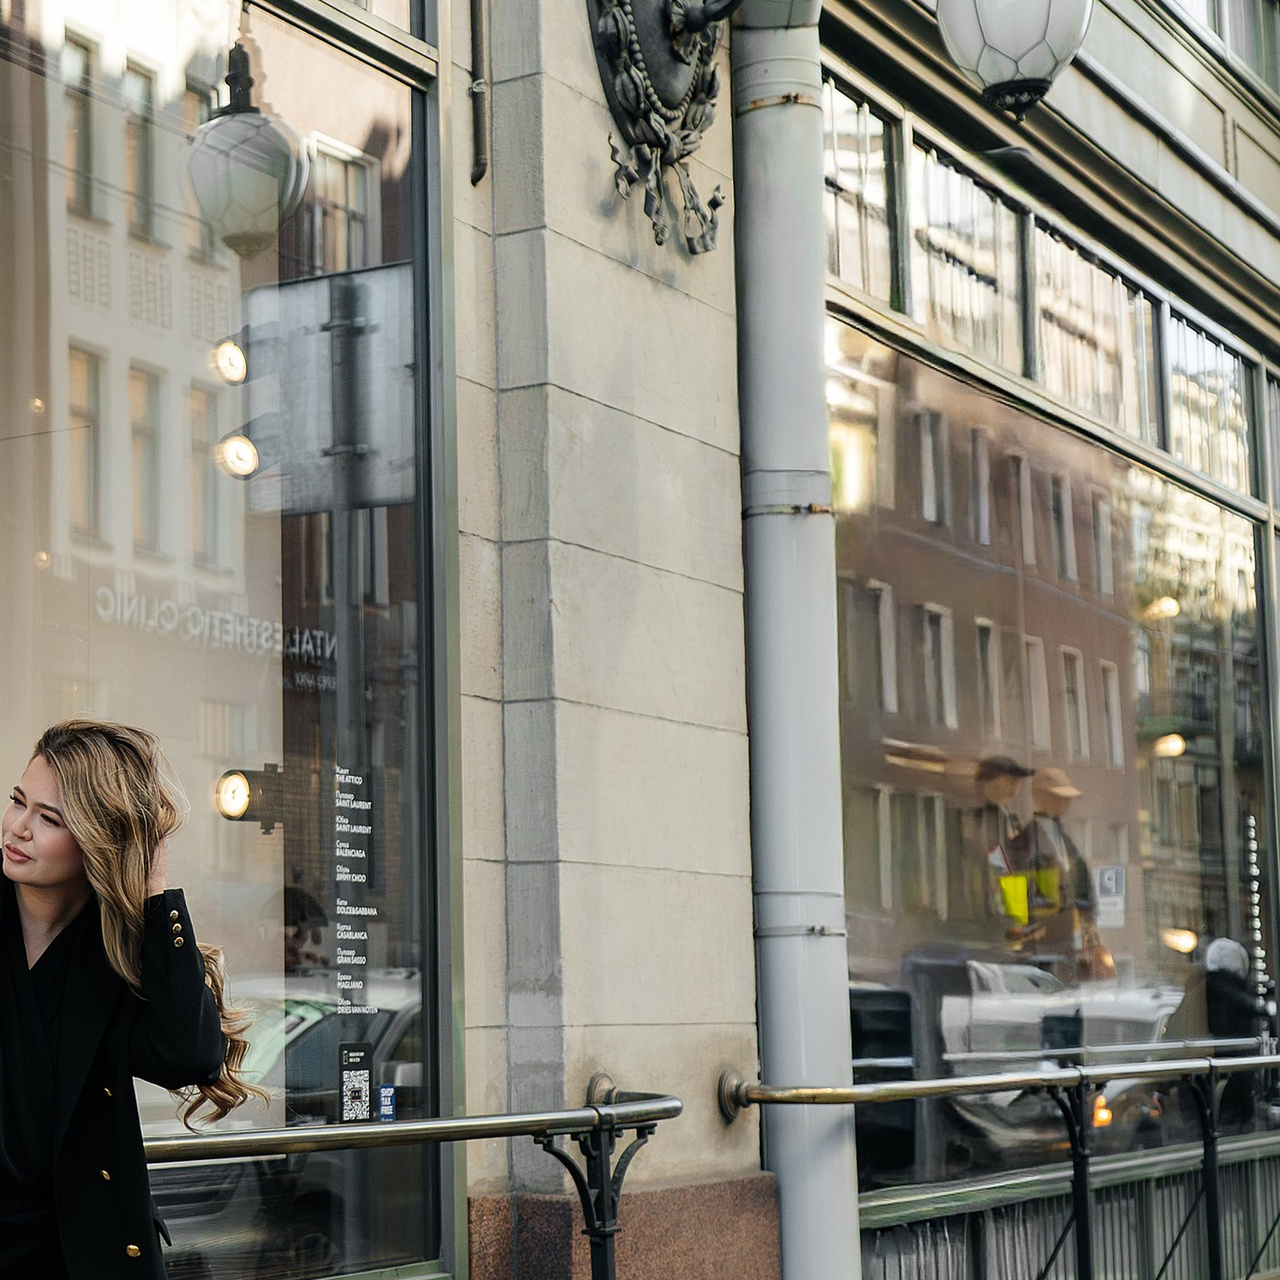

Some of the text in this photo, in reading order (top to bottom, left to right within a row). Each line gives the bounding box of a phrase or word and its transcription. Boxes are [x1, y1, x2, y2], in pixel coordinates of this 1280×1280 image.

[335, 773, 363, 785] THE ATTICO
[336, 798, 372, 810] SAINT LAURENT
[336, 823, 372, 834] SAINT LAURENT
[336, 848, 366, 858] BALENCIAGA
[336, 873, 367, 883] JIMMY CHOO
[336, 906, 378, 916] DOLCE&GABBANA
[336, 930, 368, 940] CASABLANCA
[337, 956, 367, 965] GRAN SASSO
[337, 1006, 378, 1015] DRIES VAN NOTEN
[380, 1087, 395, 1097] SHOP
[381, 1097, 392, 1106] TAX
[381, 1105, 394, 1115] FREE
